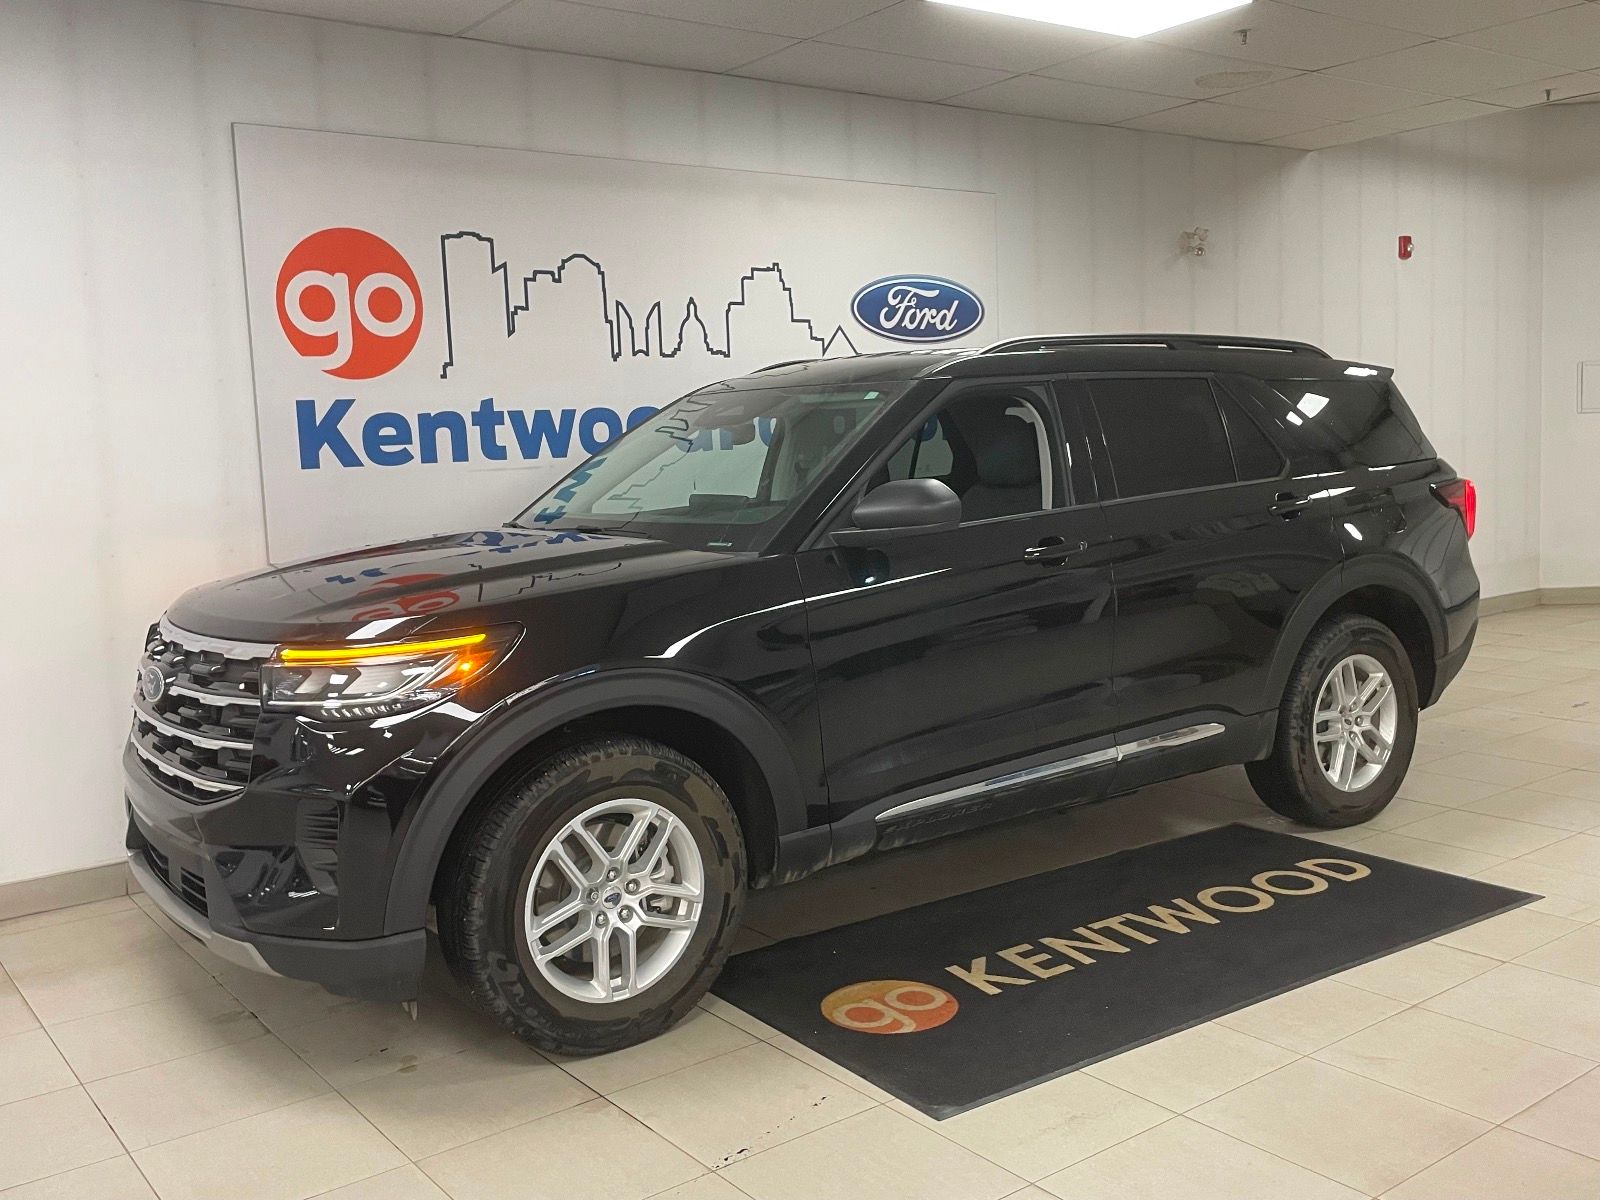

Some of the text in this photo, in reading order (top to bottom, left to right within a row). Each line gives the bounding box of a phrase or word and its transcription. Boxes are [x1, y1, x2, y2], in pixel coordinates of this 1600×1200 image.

[285, 269, 416, 370] go
[880, 285, 959, 331] Ford
[296, 398, 734, 470] Kentwo
[833, 858, 1372, 1034] go KENTWOOD
